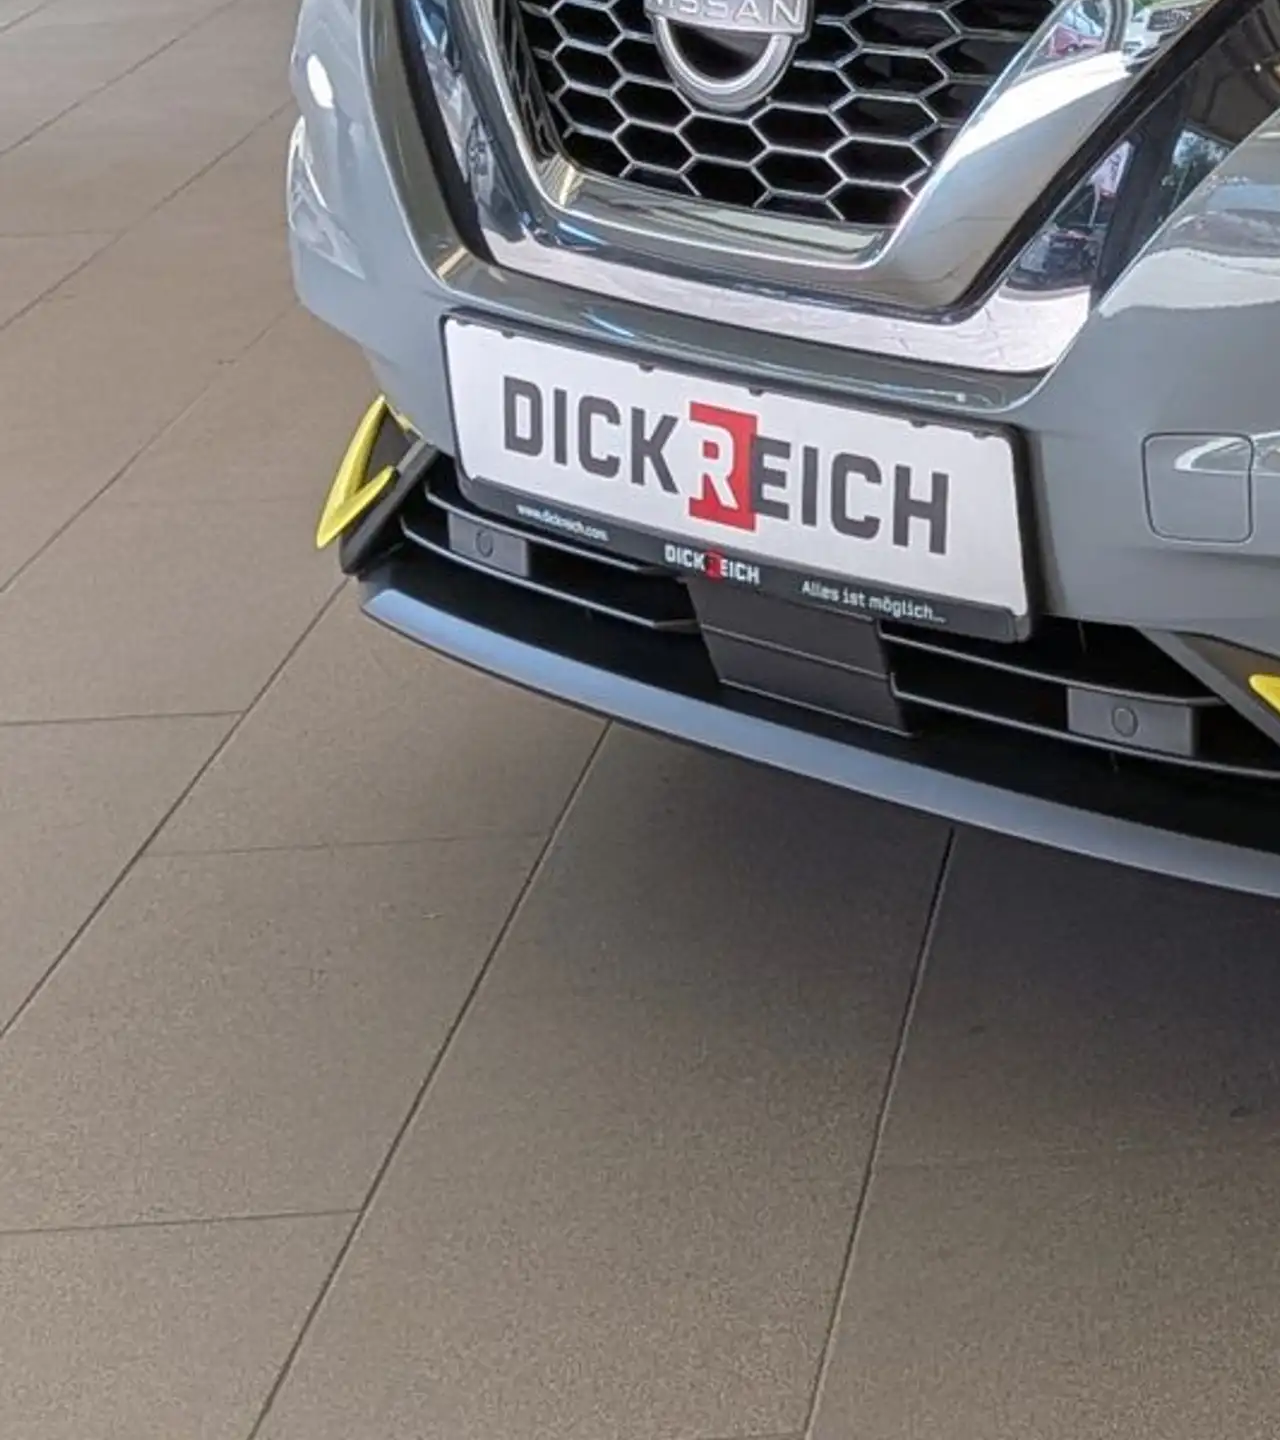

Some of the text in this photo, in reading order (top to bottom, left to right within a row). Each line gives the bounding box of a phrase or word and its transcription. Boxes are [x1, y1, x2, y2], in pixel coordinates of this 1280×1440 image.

[503, 376, 949, 556] DICKREICH
[801, 580, 840, 602] Alles
[843, 587, 866, 607] ist
